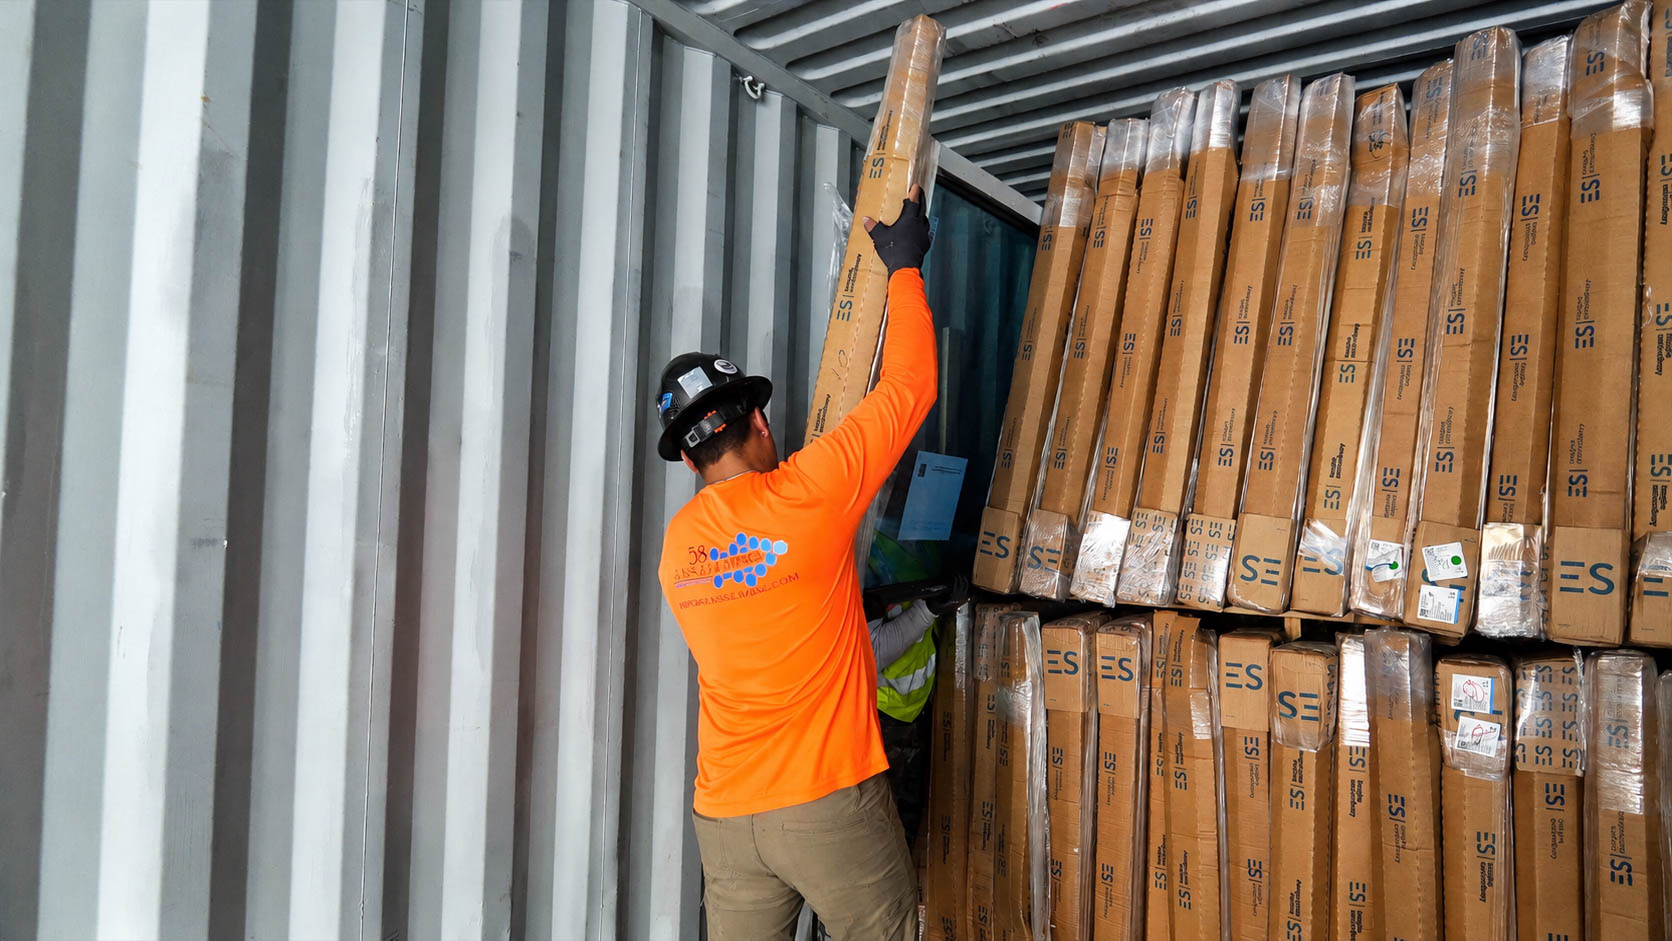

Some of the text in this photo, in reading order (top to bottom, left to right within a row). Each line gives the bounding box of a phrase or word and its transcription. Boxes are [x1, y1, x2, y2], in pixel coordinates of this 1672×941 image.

[1585, 51, 1605, 77] ES
[868, 156, 885, 180] ES
[1458, 175, 1476, 198] ES
[1581, 178, 1600, 203] ES
[1186, 199, 1197, 219] ES
[1250, 201, 1265, 221] ES
[1297, 201, 1313, 220] ES
[1521, 193, 1540, 217] ES
[1411, 206, 1429, 229] ES
[1140, 219, 1153, 237] ES
[1042, 234, 1052, 251] ES
[1094, 229, 1105, 248] ES
[1355, 240, 1372, 260] ES
[835, 299, 853, 322] ES
[1170, 318, 1181, 336] ES
[1446, 312, 1465, 335] ES
[1124, 333, 1136, 351] ES
[1234, 325, 1250, 344] ES
[1277, 325, 1293, 346] ES
[1575, 325, 1594, 349] ES
[1074, 341, 1085, 359] ES
[1397, 338, 1415, 360] ES
[1510, 334, 1529, 357] ES
[1338, 364, 1356, 384] ES
[1152, 434, 1165, 454] ES
[1054, 452, 1065, 469] ES
[1105, 447, 1118, 464] ES
[1217, 447, 1233, 467] ES
[1258, 450, 1274, 470] ES
[1434, 451, 1454, 472] ES
[1650, 454, 1672, 477] ES
[1381, 467, 1400, 488] ES
[1499, 475, 1517, 497] ES
[1568, 474, 1587, 498] ES
[1324, 490, 1341, 510] ES
[1136, 512, 1148, 528] ES
[1190, 519, 1203, 535] ES
[1209, 521, 1222, 538] ES
[980, 531, 1011, 558] ES
[1187, 541, 1199, 556] ES
[1027, 546, 1061, 571] ES
[1184, 562, 1196, 579] ES
[1240, 555, 1281, 586] ES
[1560, 561, 1615, 595] ES
[1180, 584, 1193, 600] ES
[1047, 649, 1079, 675] ES
[1101, 655, 1133, 681] ES
[1170, 668, 1182, 687] ES
[1225, 662, 1263, 690] ES
[1537, 664, 1552, 682] ES
[1277, 690, 1319, 721] ES
[1562, 692, 1578, 713] ES
[1535, 717, 1552, 738] ES
[1562, 720, 1578, 741] ES
[1052, 746, 1064, 766] ES
[1244, 736, 1259, 756] ES
[1535, 745, 1552, 765] ES
[1104, 752, 1116, 771] ES
[1349, 746, 1365, 768] ES
[1562, 748, 1579, 768] ES
[1174, 770, 1187, 791] ES
[1290, 788, 1304, 810] ES
[1545, 783, 1564, 806] ES
[1388, 794, 1405, 817] ES
[1476, 832, 1496, 854] ES
[1050, 859, 1062, 876] ES
[1101, 863, 1114, 883] ES
[1248, 859, 1262, 879] ES
[1610, 859, 1632, 886] ES
[1154, 873, 1166, 890] ES
[1179, 888, 1191, 910] ES
[1349, 882, 1366, 902] ES
